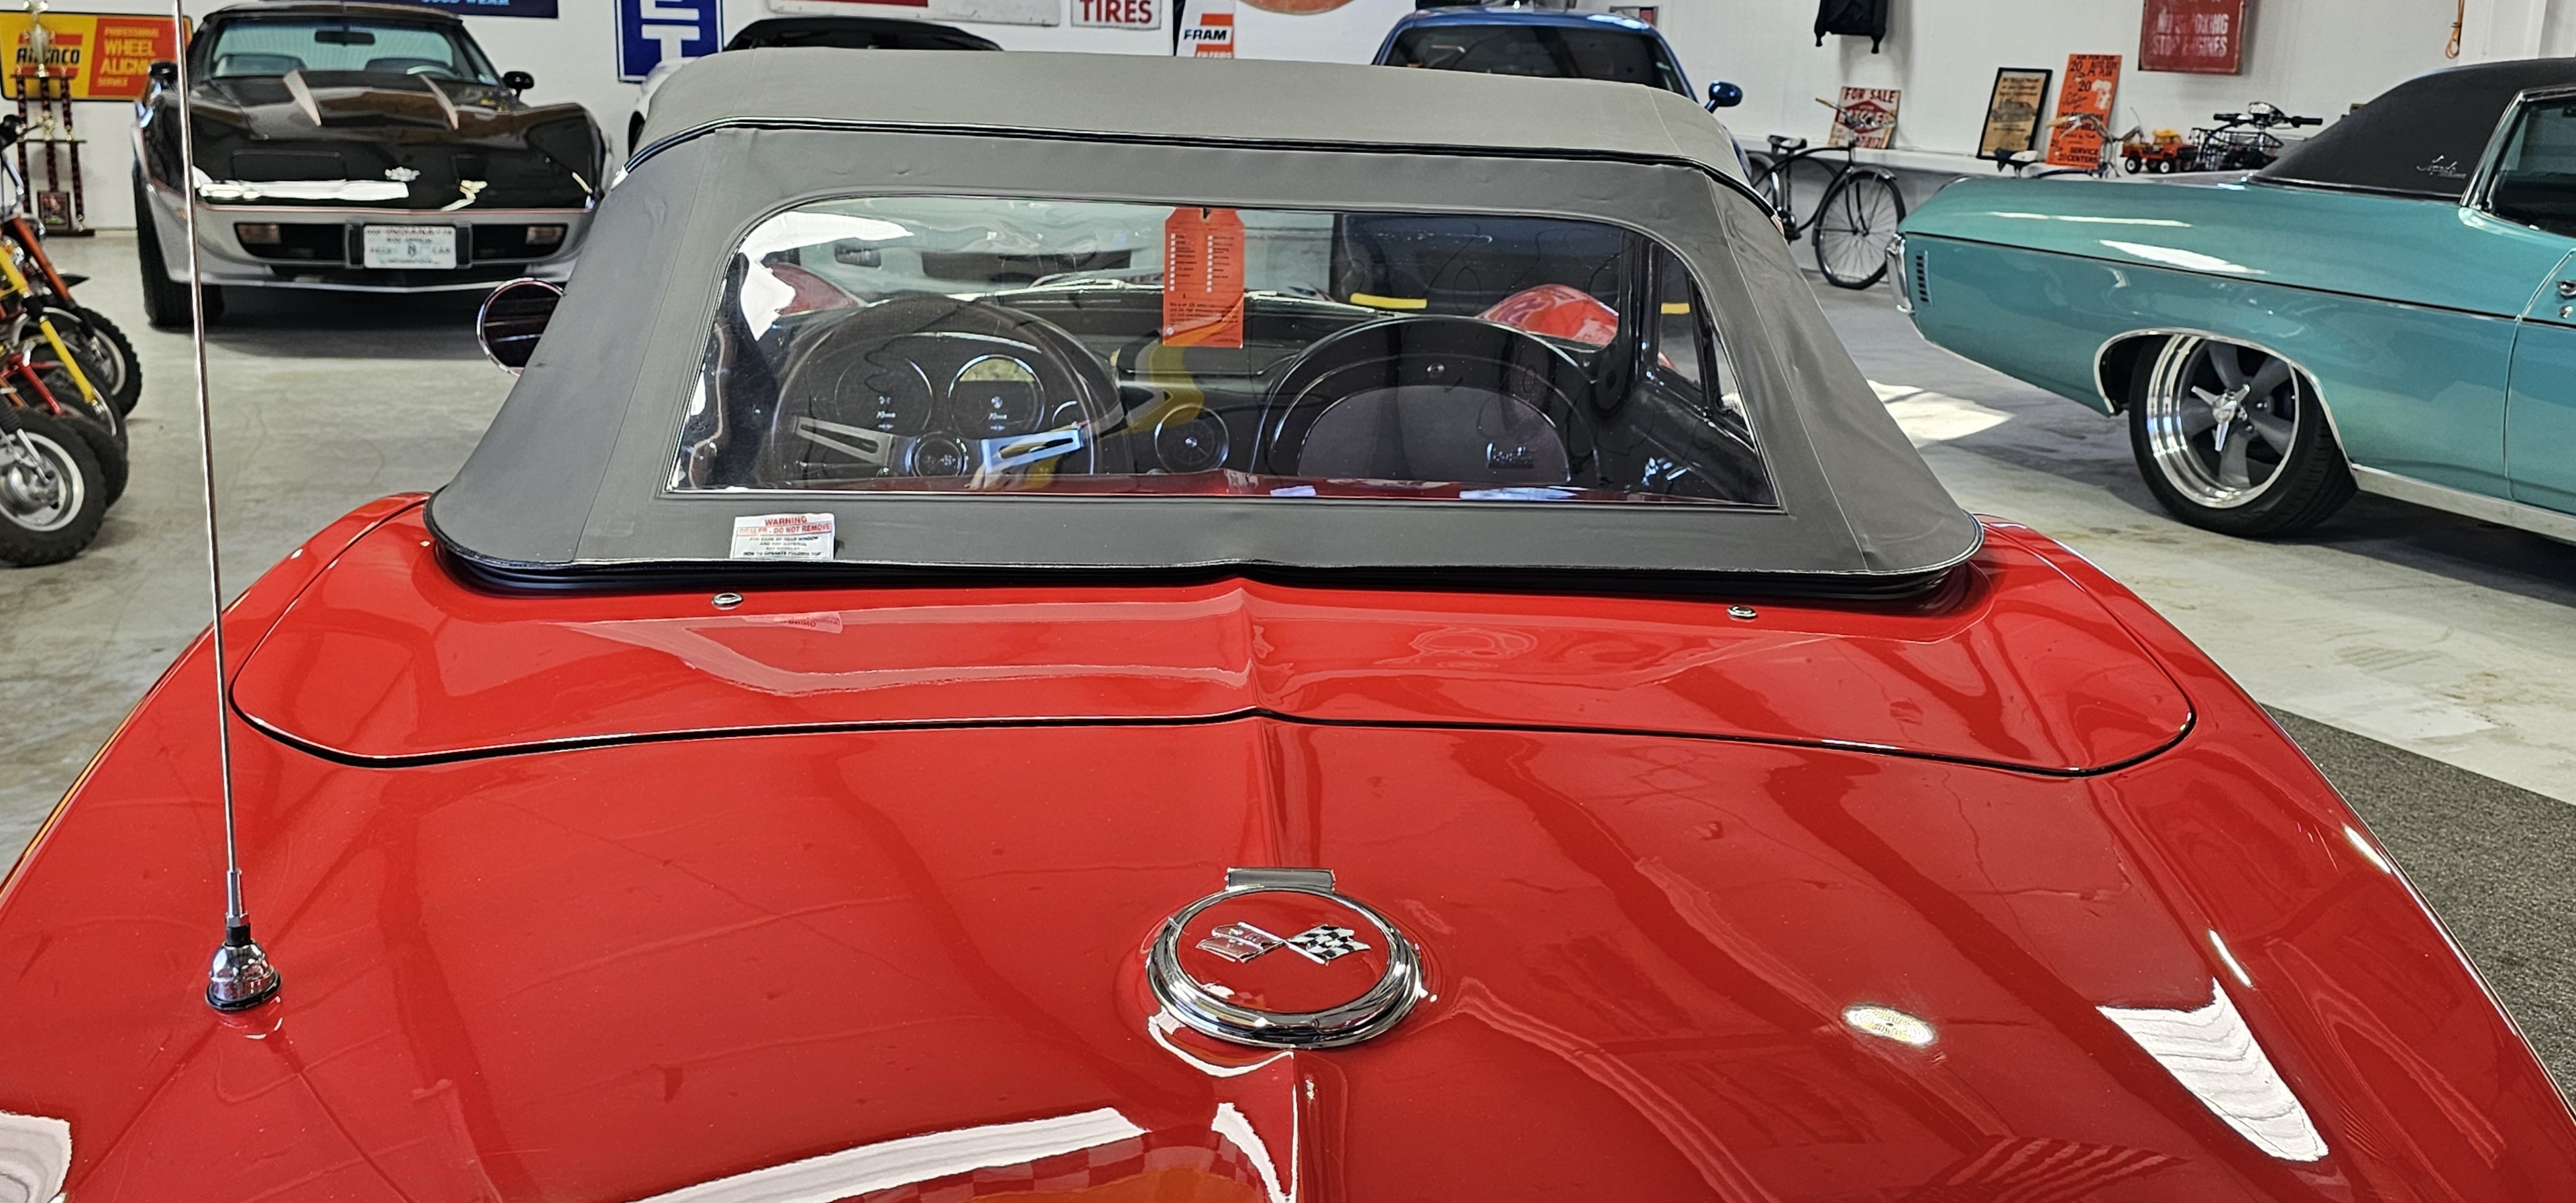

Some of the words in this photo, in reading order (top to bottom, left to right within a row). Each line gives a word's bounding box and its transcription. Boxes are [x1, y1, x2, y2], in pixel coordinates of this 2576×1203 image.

[1080, 0, 1152, 24] TIRES
[1184, 29, 1227, 41] FRAM
[104, 38, 156, 56] WHEEL
[2078, 80, 2092, 92] 20
[1844, 88, 1865, 100] FOR
[1870, 90, 1896, 103] SALE
[765, 516, 807, 526] WARNING
[802, 522, 830, 532] REMOVE
